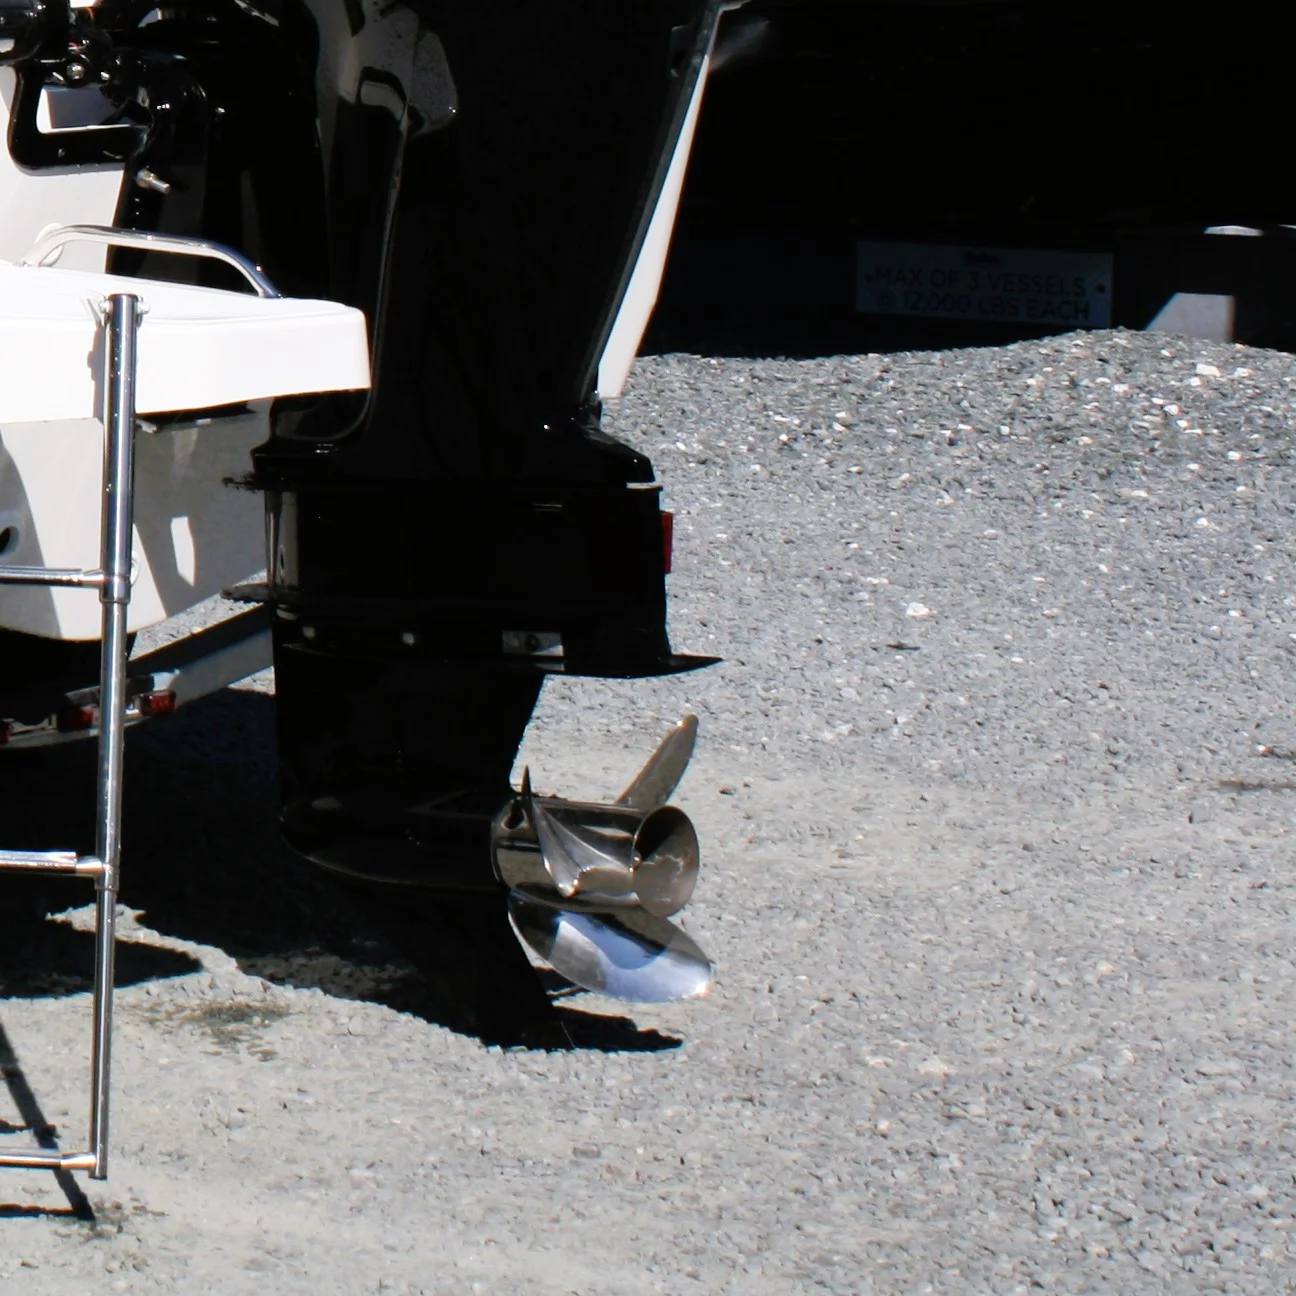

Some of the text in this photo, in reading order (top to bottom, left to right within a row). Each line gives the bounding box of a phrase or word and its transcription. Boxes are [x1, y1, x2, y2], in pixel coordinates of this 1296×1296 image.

[873, 265, 1087, 297] MAX OF 3 VESSELS
[978, 296, 1020, 317] LBS
[1027, 298, 1091, 321] EACH
